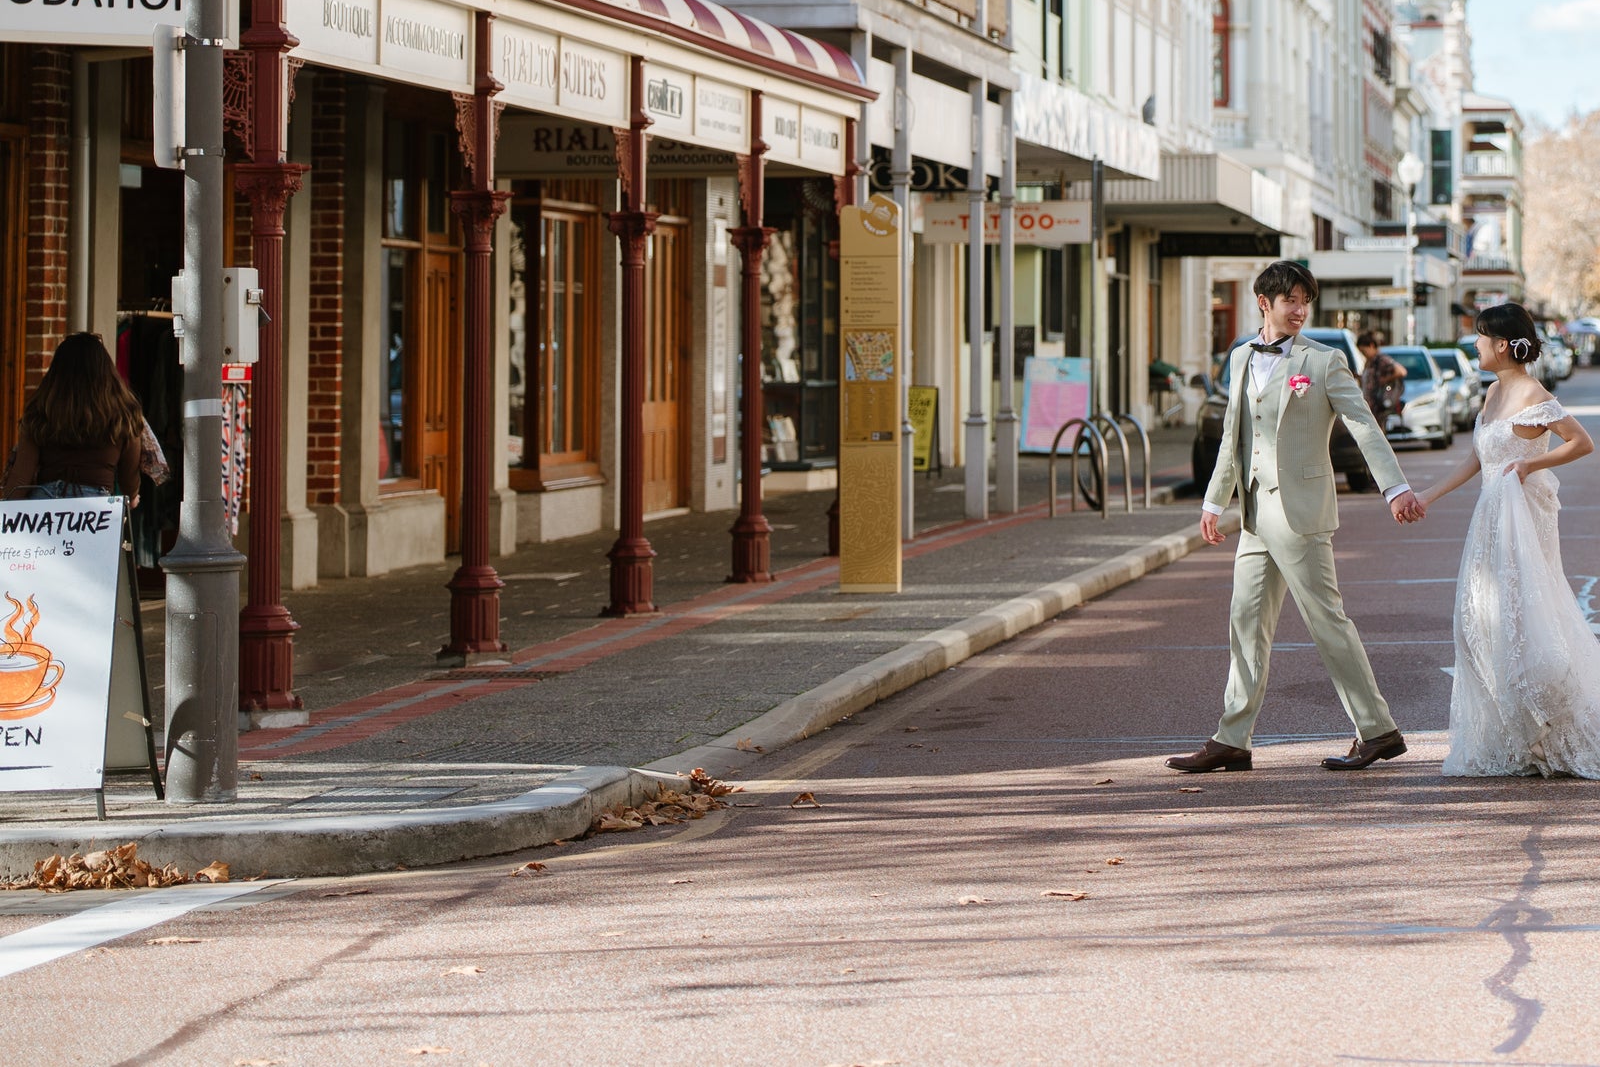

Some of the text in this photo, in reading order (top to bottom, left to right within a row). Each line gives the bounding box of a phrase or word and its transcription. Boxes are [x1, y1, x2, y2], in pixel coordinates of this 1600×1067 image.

[385, 15, 464, 60] ACCOMMODATION
[503, 34, 557, 89] RIALTO
[564, 51, 606, 101] SUITES
[533, 126, 615, 153] RIAL
[566, 153, 734, 167] BOUTIQU OMMODATION
[958, 213, 1055, 231] TTOO
[2, 510, 113, 536] WNATURE
[34, 545, 56, 559] food
